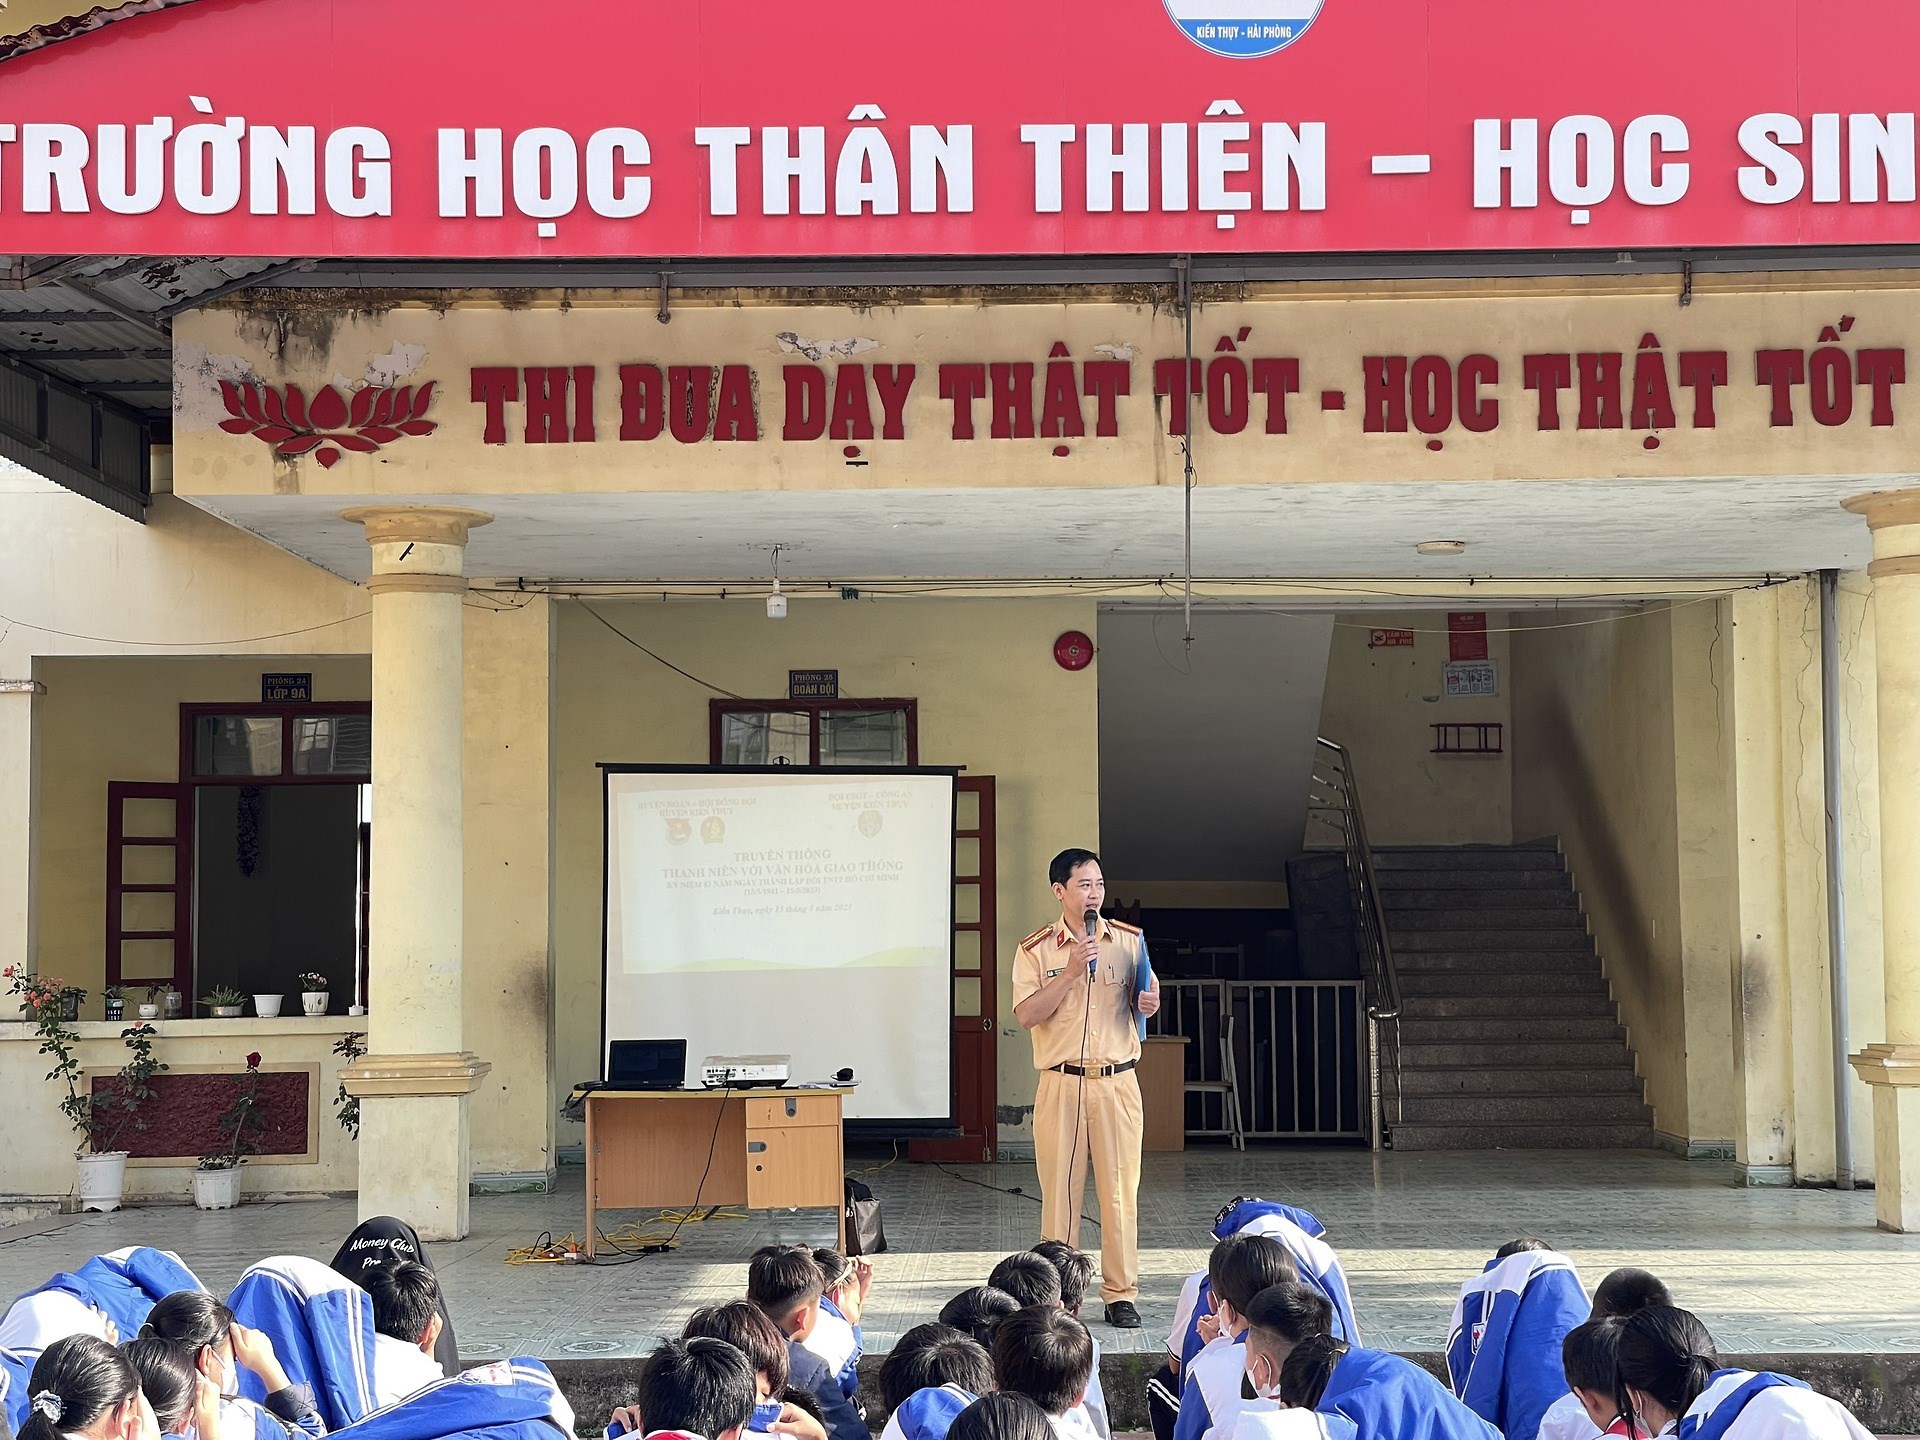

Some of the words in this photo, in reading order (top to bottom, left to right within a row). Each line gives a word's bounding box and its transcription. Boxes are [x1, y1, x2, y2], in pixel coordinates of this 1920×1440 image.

[1197, 23, 1216, 38] KIẾN
[1218, 27, 1239, 41] THỤY
[1247, 24, 1261, 38] HẢI
[1264, 24, 1292, 38] PHÒNG
[438, 127, 652, 238] HỌC
[694, 103, 974, 216] THÂN
[1020, 99, 1327, 229] THIỆN
[1473, 114, 1690, 225] HỌC
[1737, 112, 1917, 204] SIN
[471, 366, 596, 446] THI
[619, 364, 758, 444] ĐUA
[782, 363, 915, 458] DẠY
[939, 341, 1131, 458] THẬT
[1154, 326, 1299, 436] TỐT
[1363, 354, 1499, 452] HỌC
[1523, 332, 1728, 450] THẬT
[1756, 316, 1906, 427] TỐT
[267, 686, 288, 699] LỚP
[291, 688, 306, 699] 9A
[794, 683, 817, 695] ĐOÀN
[820, 683, 834, 696] ĐỘI
[662, 868, 705, 878] THANH
[708, 865, 738, 877] NIÊN
[741, 864, 763, 876] VỚI
[824, 862, 857, 873] GIAO
[859, 859, 904, 872] THÔNG
[350, 1238, 389, 1251] Money
[391, 1238, 415, 1253] Club
